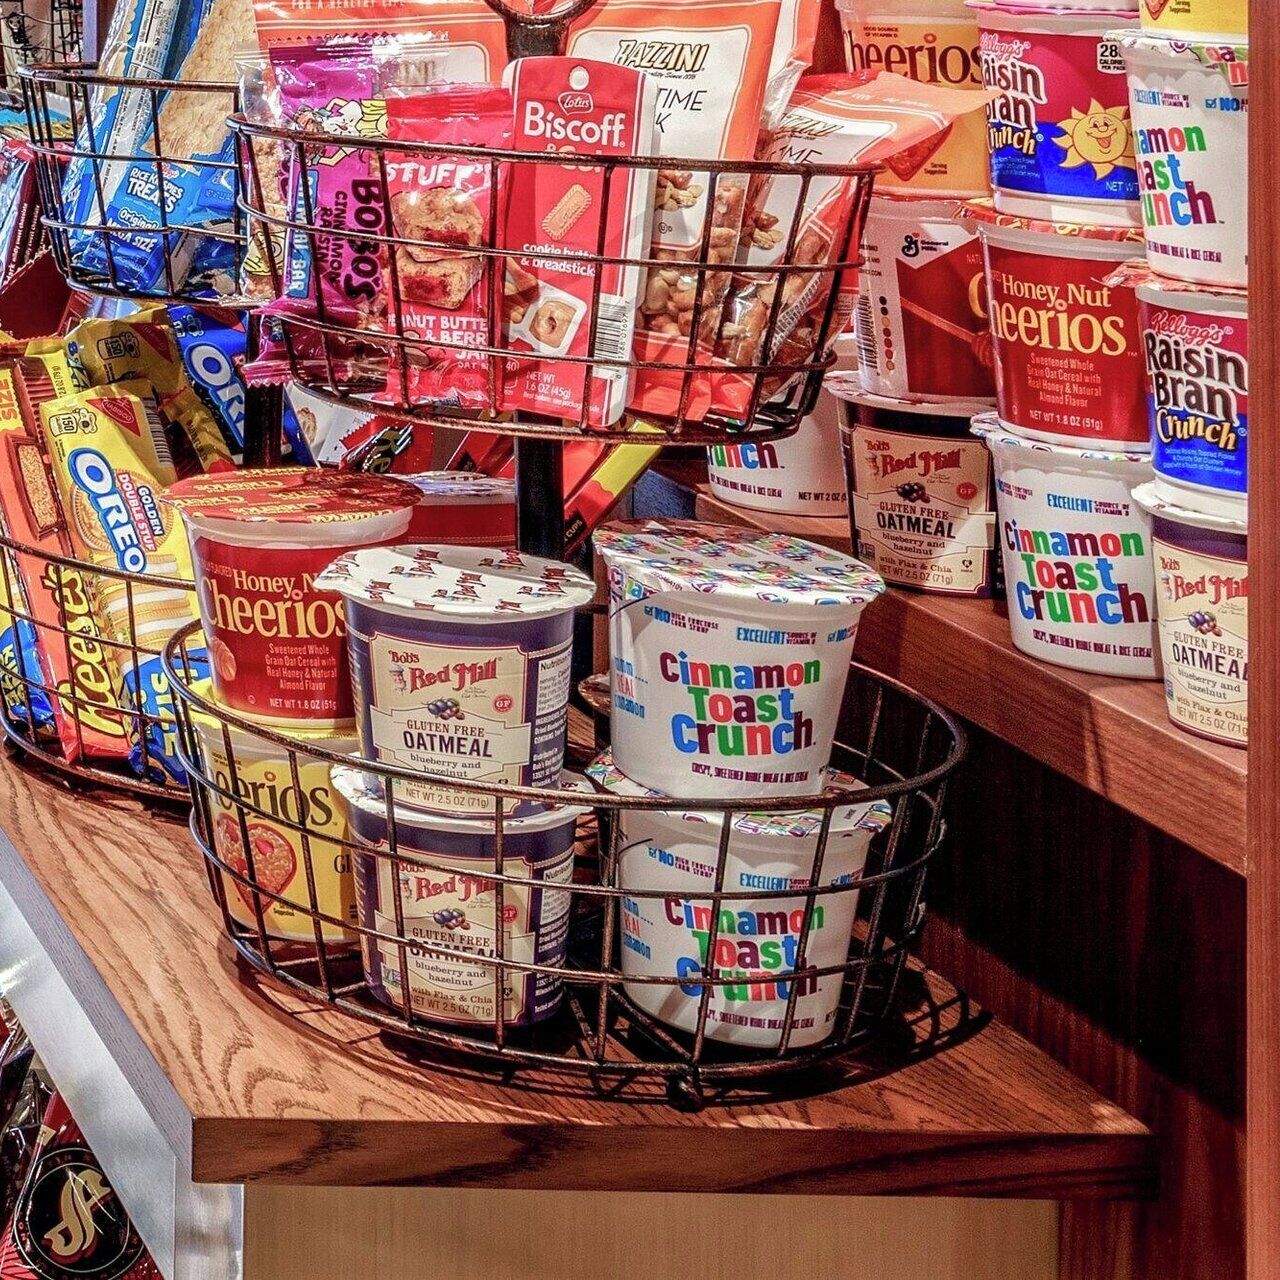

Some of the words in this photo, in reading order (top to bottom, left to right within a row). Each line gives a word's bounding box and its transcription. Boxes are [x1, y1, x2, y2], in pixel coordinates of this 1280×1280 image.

[292, 0, 313, 9] FOR
[614, 39, 705, 73] BAZZINI
[563, 94, 593, 113] Lotus
[658, 88, 704, 113] TIME
[1219, 97, 1239, 112] NO
[524, 101, 623, 147] Biscoff
[130, 166, 152, 184] RICE
[1105, 180, 1126, 192] NET
[1002, 276, 1057, 302] Honey
[1067, 282, 1111, 308] Nut
[525, 381, 536, 391] 1.6
[537, 383, 549, 393] OZ
[551, 385, 572, 399] (45g)
[543, 374, 555, 383] WT
[881, 449, 916, 473] Red
[918, 449, 961, 473] Mill
[70, 447, 148, 573] OREO
[877, 512, 956, 540] OATMEAL
[1005, 519, 1144, 557] Cinnamon
[1022, 555, 1116, 590] Toast
[233, 569, 294, 600] Honey
[1017, 583, 1149, 625] Crunch
[737, 627, 785, 644] EXCELLENT
[1173, 631, 1209, 646] GLUTEN
[1212, 638, 1244, 655] FREE
[268, 644, 309, 655] Sweetened
[310, 645, 329, 655] Whole
[410, 666, 445, 693] Red
[447, 658, 499, 691] Mill
[660, 652, 821, 689] Cinnamon
[1177, 667, 1221, 684] blueberry
[1223, 677, 1241, 690] and
[279, 680, 302, 690] Almond
[304, 680, 326, 691] Flavor
[1187, 681, 1228, 700] hazelnut
[270, 698, 282, 708] NET
[283, 699, 295, 708] WT
[308, 700, 320, 710] OZ
[687, 687, 794, 723] Toast
[406, 721, 447, 734] GLUTEN
[453, 725, 485, 737] FREE
[672, 710, 812, 757] Crunch
[404, 731, 493, 758] OATMEAL
[415, 960, 462, 976] blueberry
[464, 968, 486, 978] and
[429, 973, 473, 987] hazelnut
[441, 1001, 456, 1011] 2.5
[472, 1003, 494, 1017] (71g)
